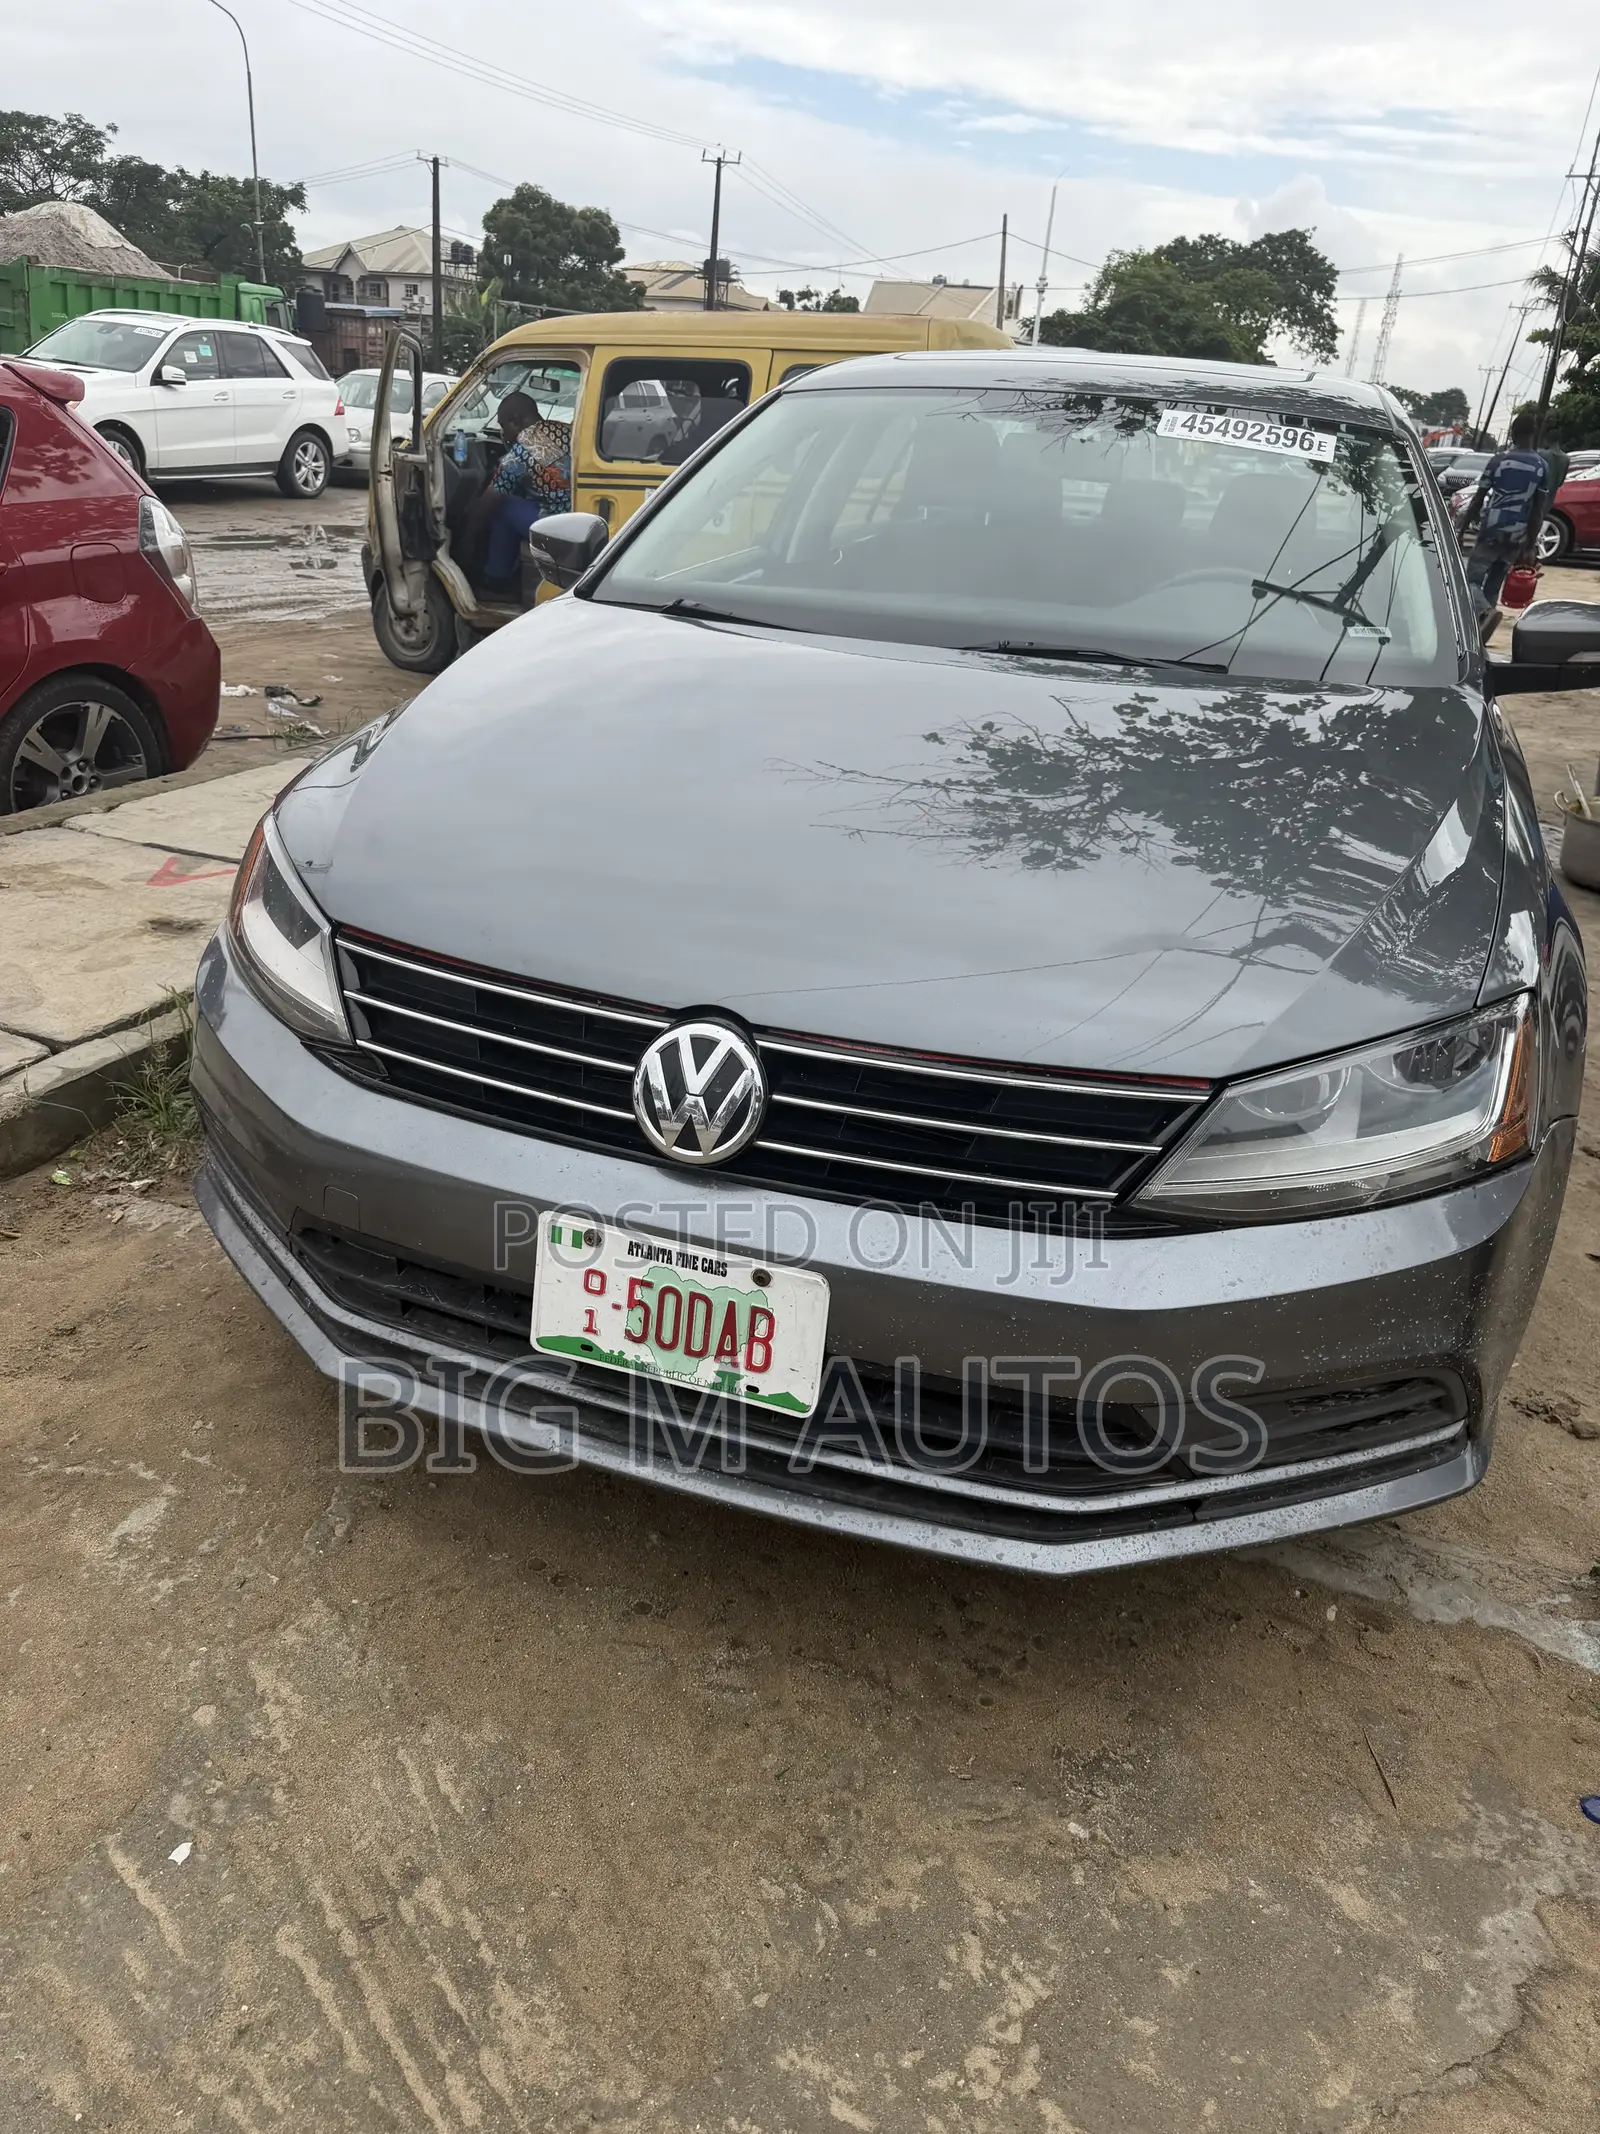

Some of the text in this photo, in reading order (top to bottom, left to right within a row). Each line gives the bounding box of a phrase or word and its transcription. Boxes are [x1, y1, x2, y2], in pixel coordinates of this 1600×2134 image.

[627, 1240, 728, 1278] ATLANTA FINE CARS
